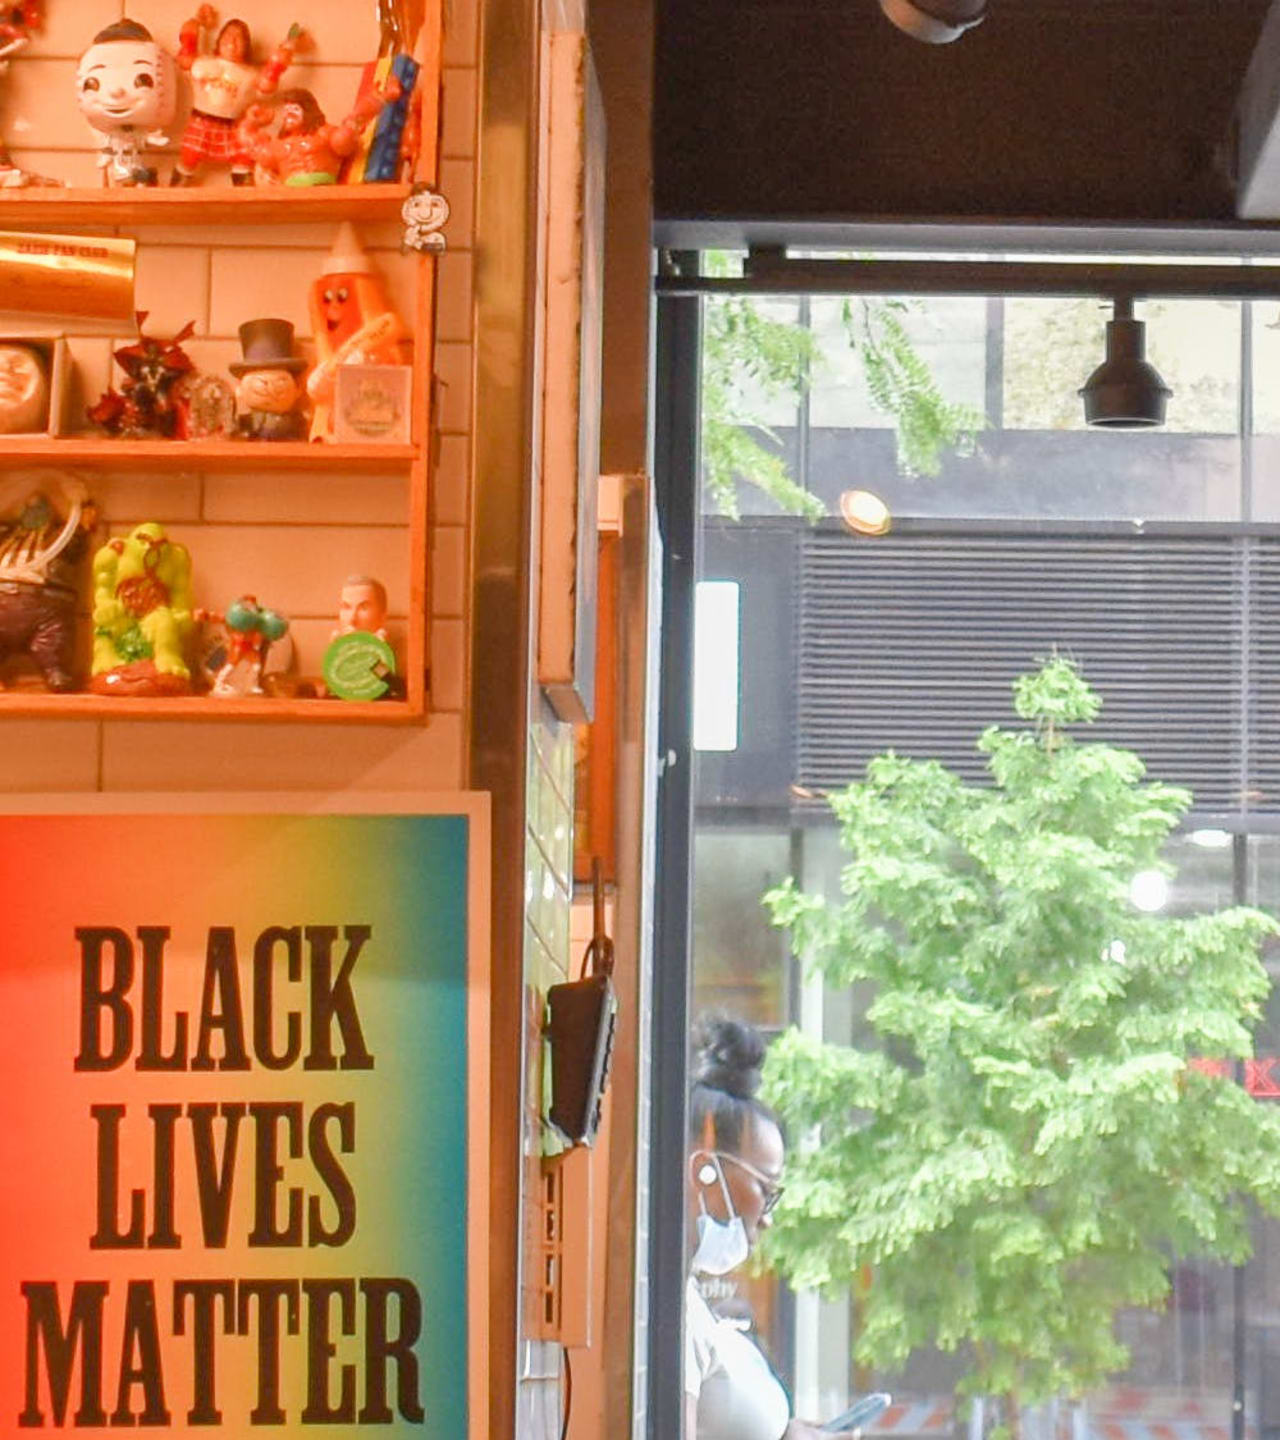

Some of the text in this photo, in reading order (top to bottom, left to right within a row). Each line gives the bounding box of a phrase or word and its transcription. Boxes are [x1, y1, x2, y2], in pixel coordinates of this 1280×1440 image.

[73, 924, 375, 1073] BLACK
[88, 1101, 358, 1251] LIVES
[17, 1277, 426, 1429] MATTER
